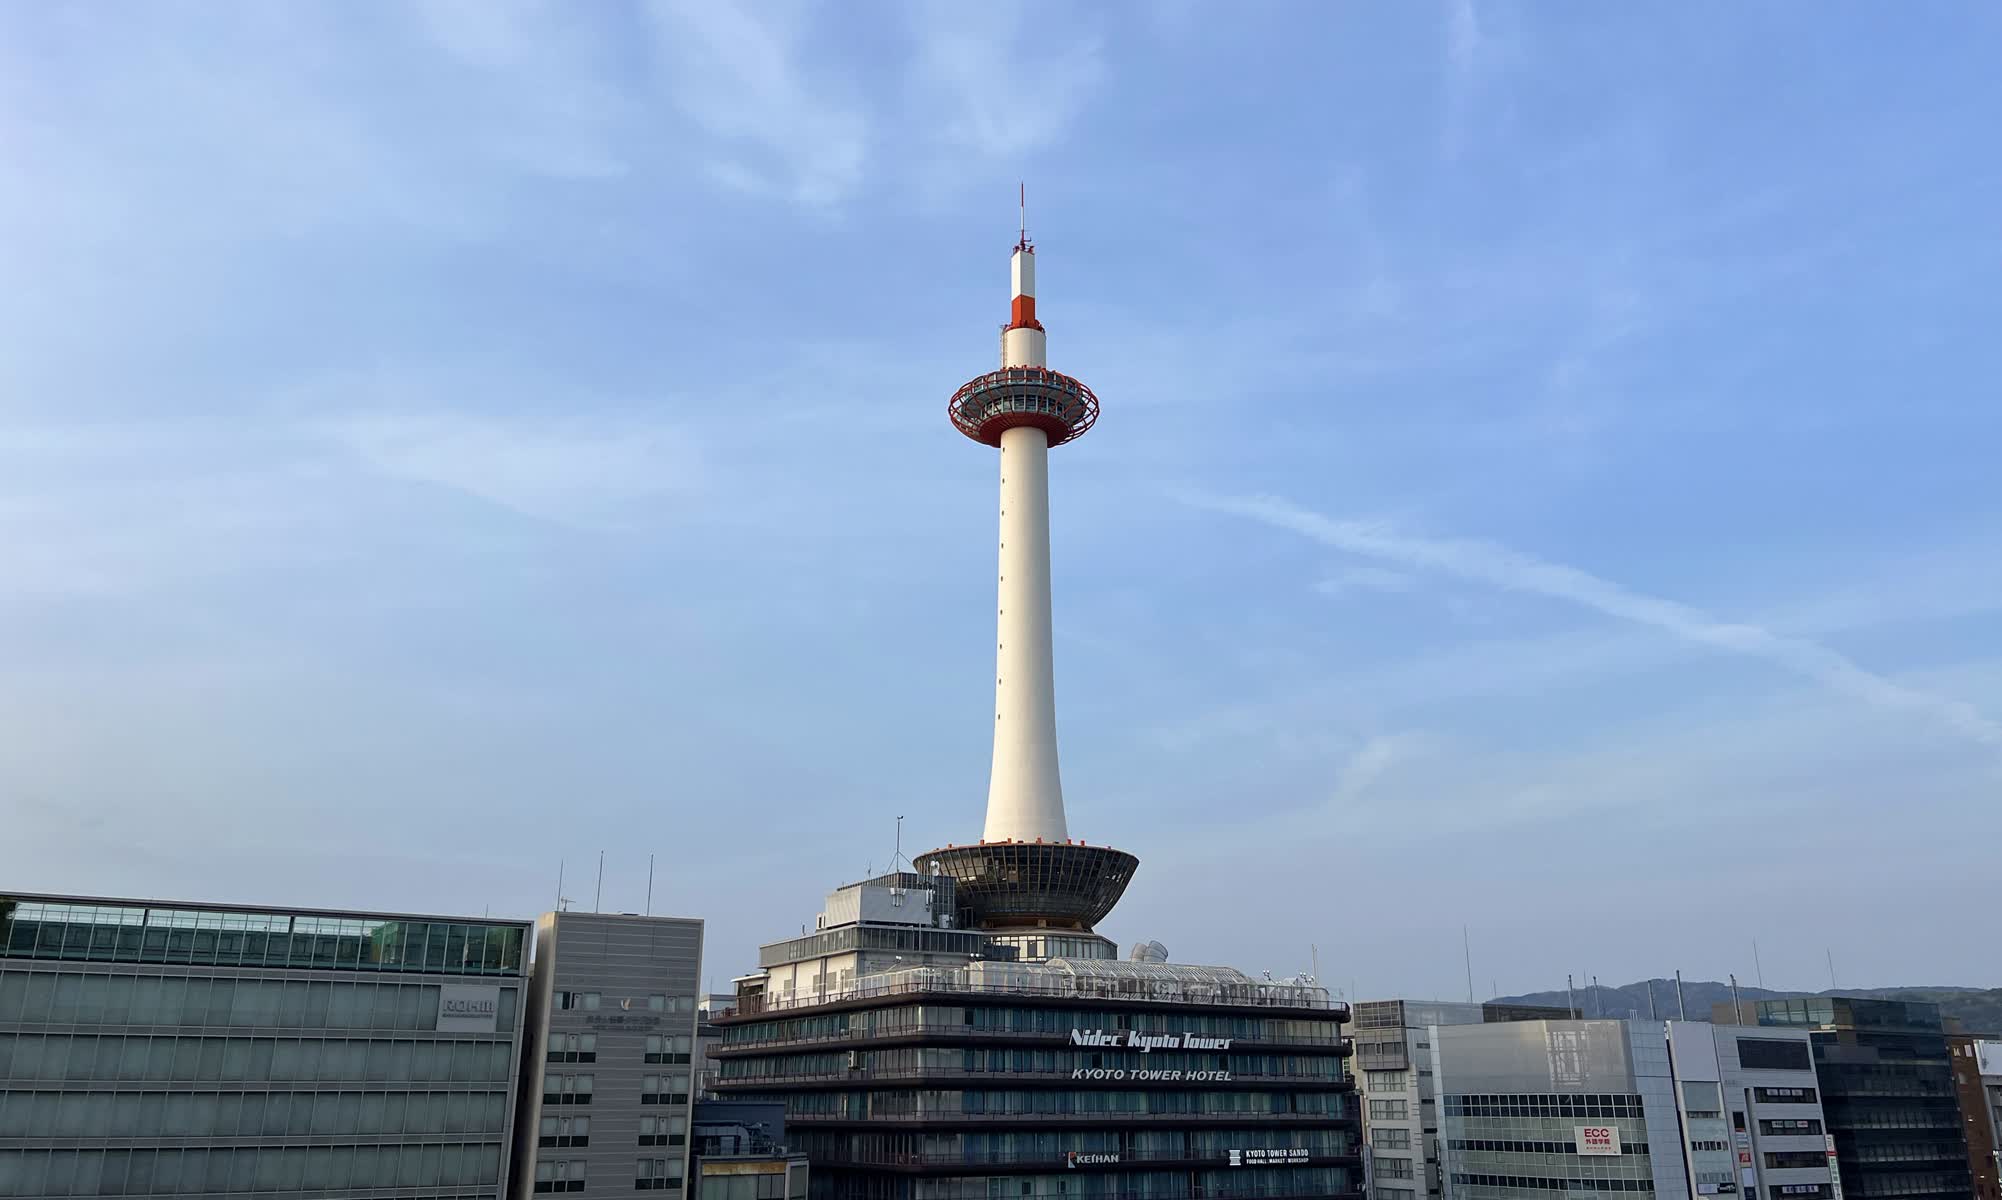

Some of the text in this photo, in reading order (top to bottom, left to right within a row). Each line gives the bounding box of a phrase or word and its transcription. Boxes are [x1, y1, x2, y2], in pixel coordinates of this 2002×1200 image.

[1069, 1028, 1234, 1053] Nidec Kyoto Tower
[1071, 1068, 1232, 1081] KYOTO TOWER HOTEL
[1584, 1128, 1609, 1138] ECC
[1076, 1153, 1119, 1164] KEIHAN
[1245, 1148, 1309, 1158] KYOTO TOWER SANDO
